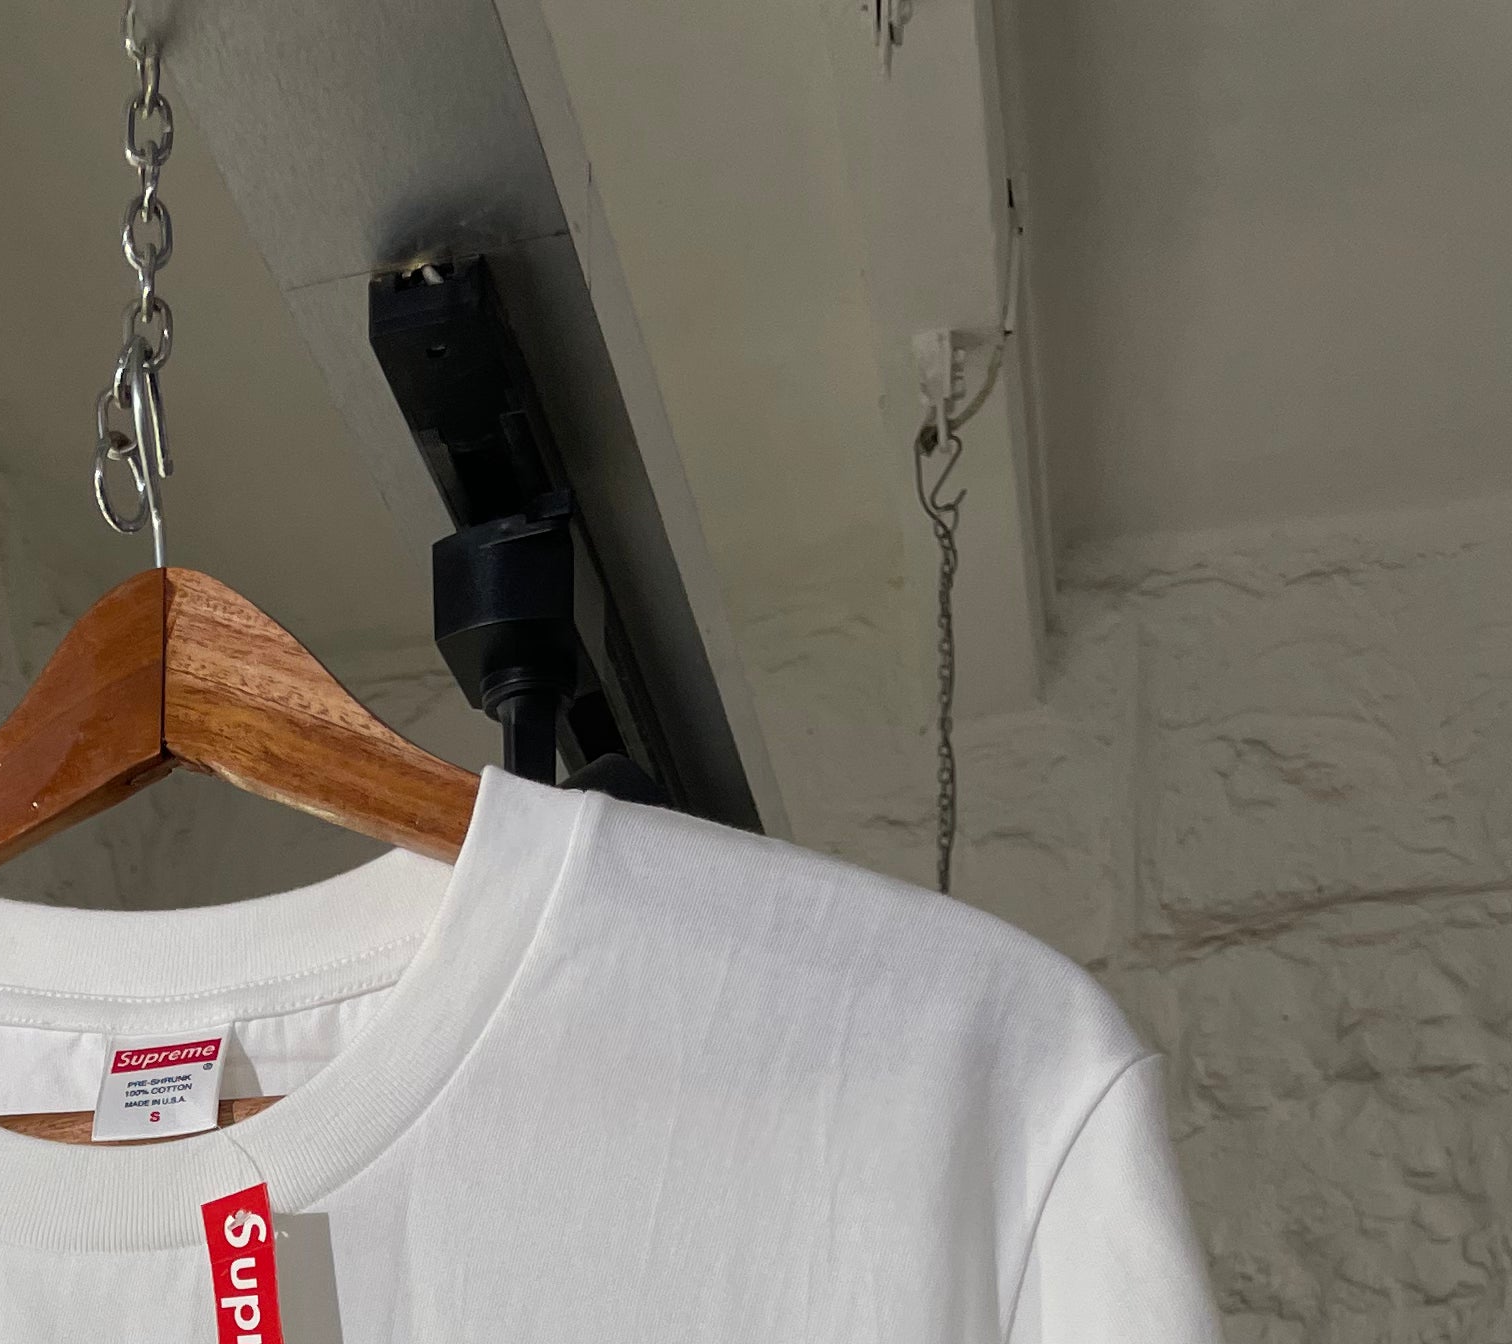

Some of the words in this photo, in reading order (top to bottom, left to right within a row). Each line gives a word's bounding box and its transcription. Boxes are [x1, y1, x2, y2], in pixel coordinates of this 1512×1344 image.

[117, 1044, 216, 1069] Supreme
[127, 1074, 192, 1088] PRE-SHRUNK
[125, 1089, 149, 1097] 100%
[150, 1083, 193, 1095] COTTON
[124, 1099, 150, 1108] MADE
[151, 1098, 161, 1106] IN
[149, 1111, 161, 1122] S
